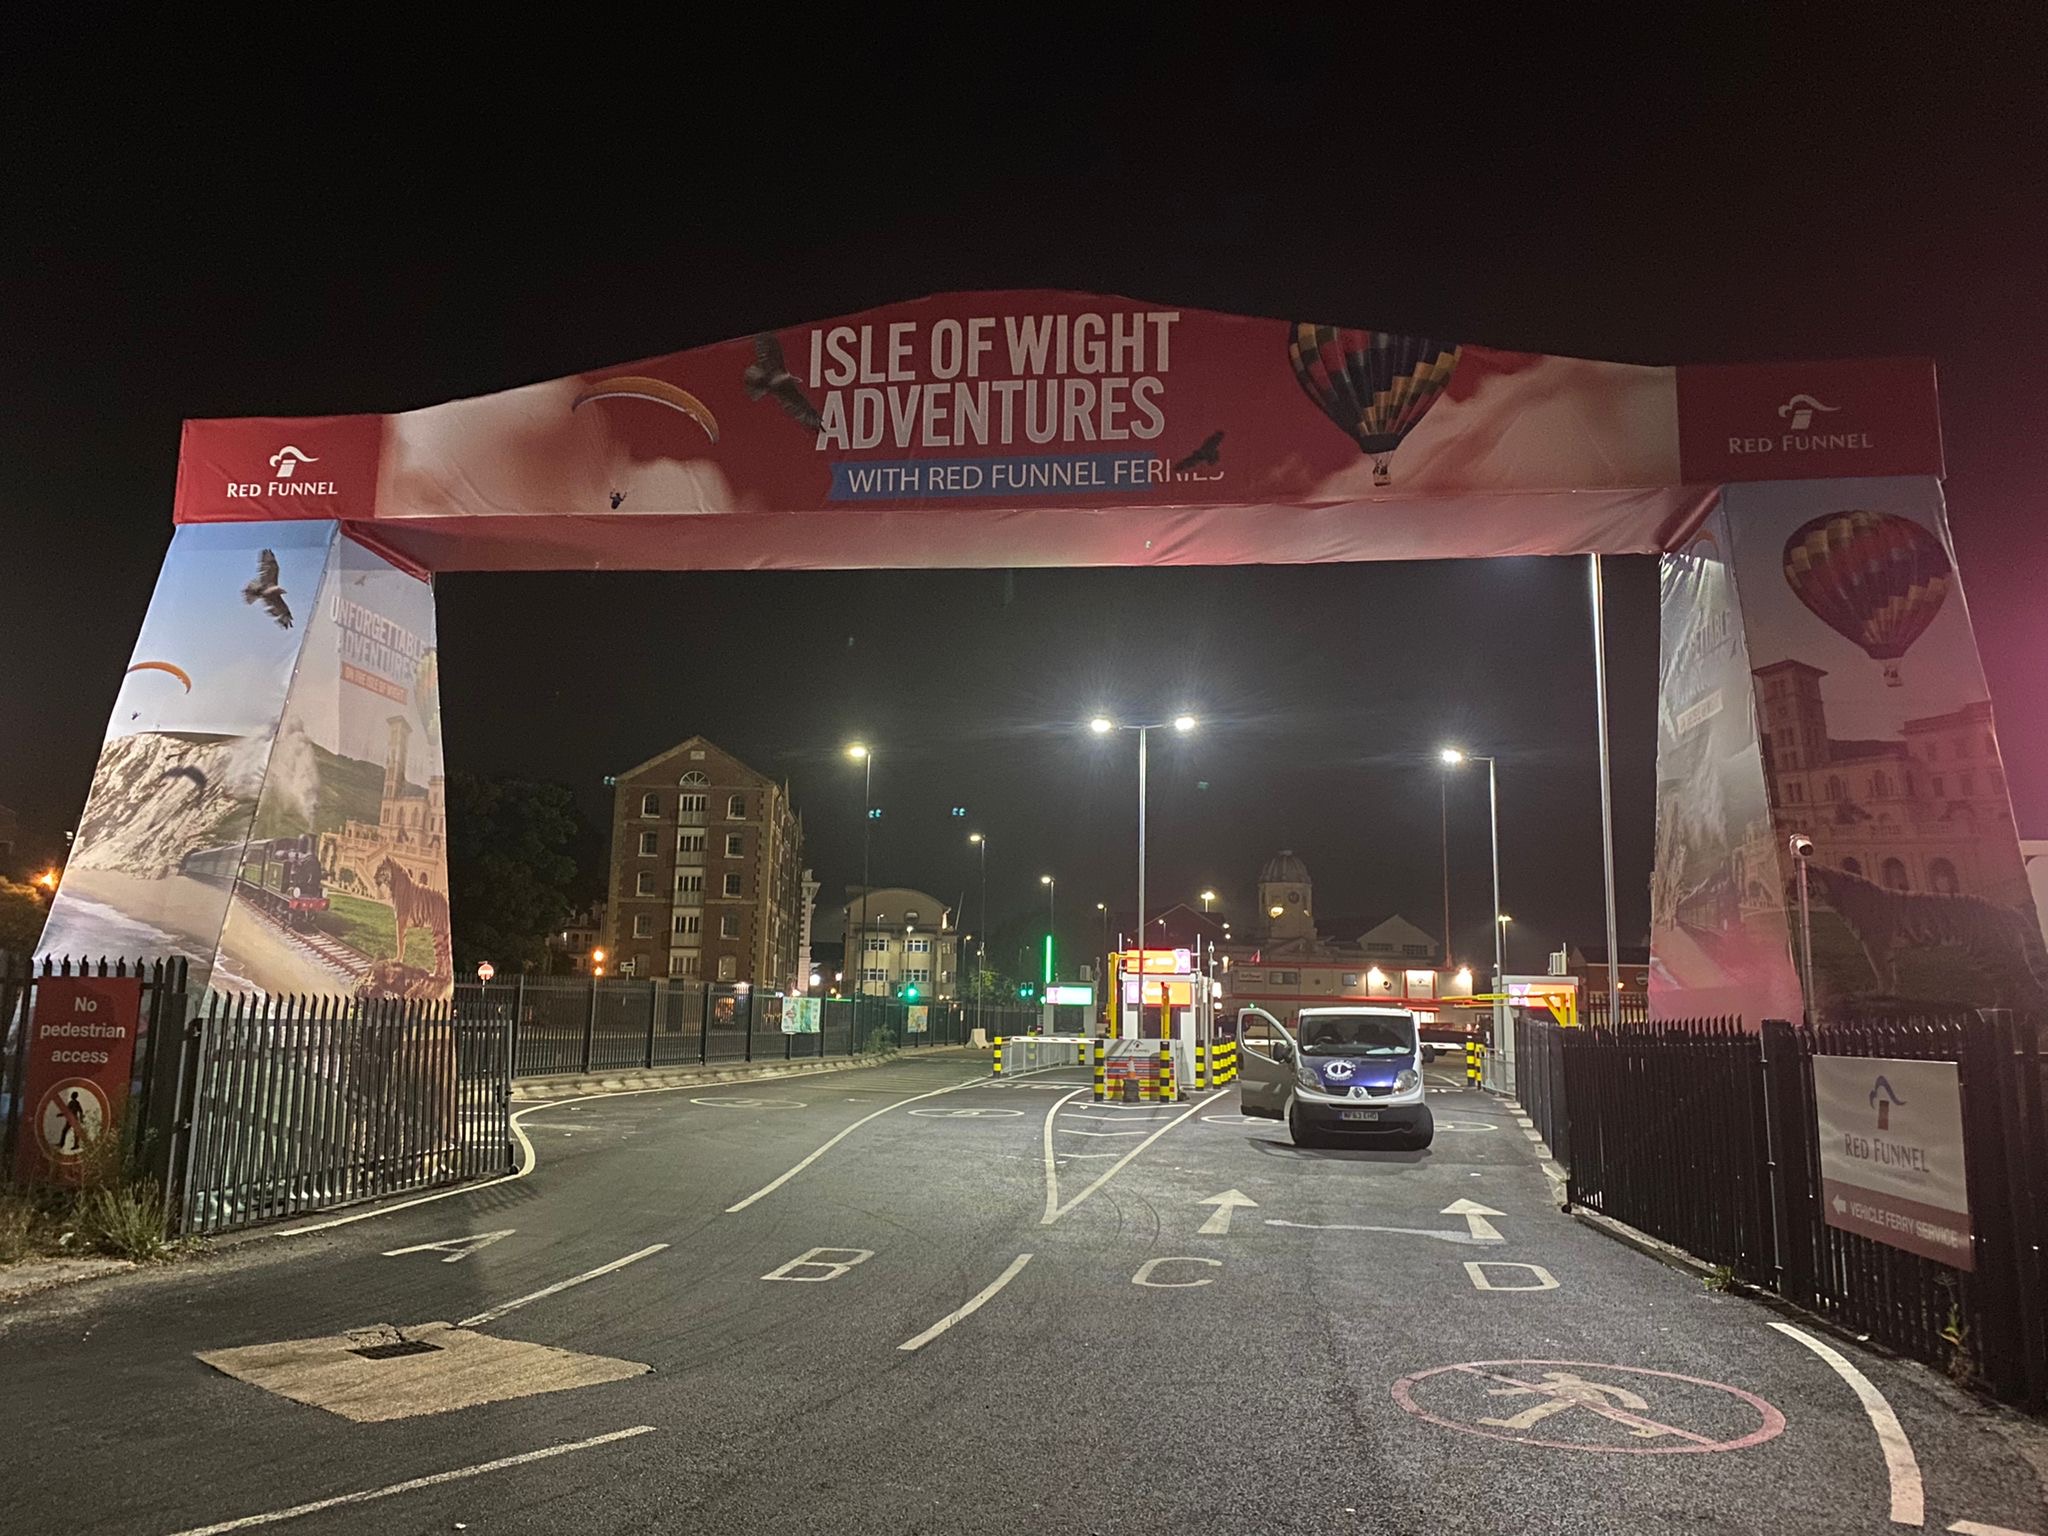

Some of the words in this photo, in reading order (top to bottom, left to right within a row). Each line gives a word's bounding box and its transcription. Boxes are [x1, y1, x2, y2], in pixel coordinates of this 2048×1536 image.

[810, 321, 917, 389] ISLE
[930, 317, 996, 379] OF
[1004, 311, 1180, 376] WIGHT
[816, 376, 1166, 451] ADVENTURES
[1728, 436, 1773, 454] RED
[1782, 433, 1873, 452] FUNNEL
[227, 482, 262, 498] RED
[268, 481, 338, 497] FUNNEL
[848, 467, 920, 494] WITH
[928, 464, 983, 490] RED
[991, 460, 1106, 489] FUNNEL
[330, 595, 425, 661] UNFORGETTABLE
[337, 628, 418, 683] ADVENTURES
[74, 996, 98, 1012] No
[40, 1022, 126, 1040] pedestrian
[51, 1050, 109, 1064] access
[1844, 1133, 1870, 1160] RED
[1873, 1138, 1930, 1173] FUNNEL
[1849, 1201, 1885, 1226] VEHICLE
[1885, 1210, 1914, 1234] FERRY
[380, 1229, 516, 1262] A
[760, 1247, 875, 1283] B
[1132, 1256, 1222, 1288] C
[1463, 1262, 1560, 1291] D
